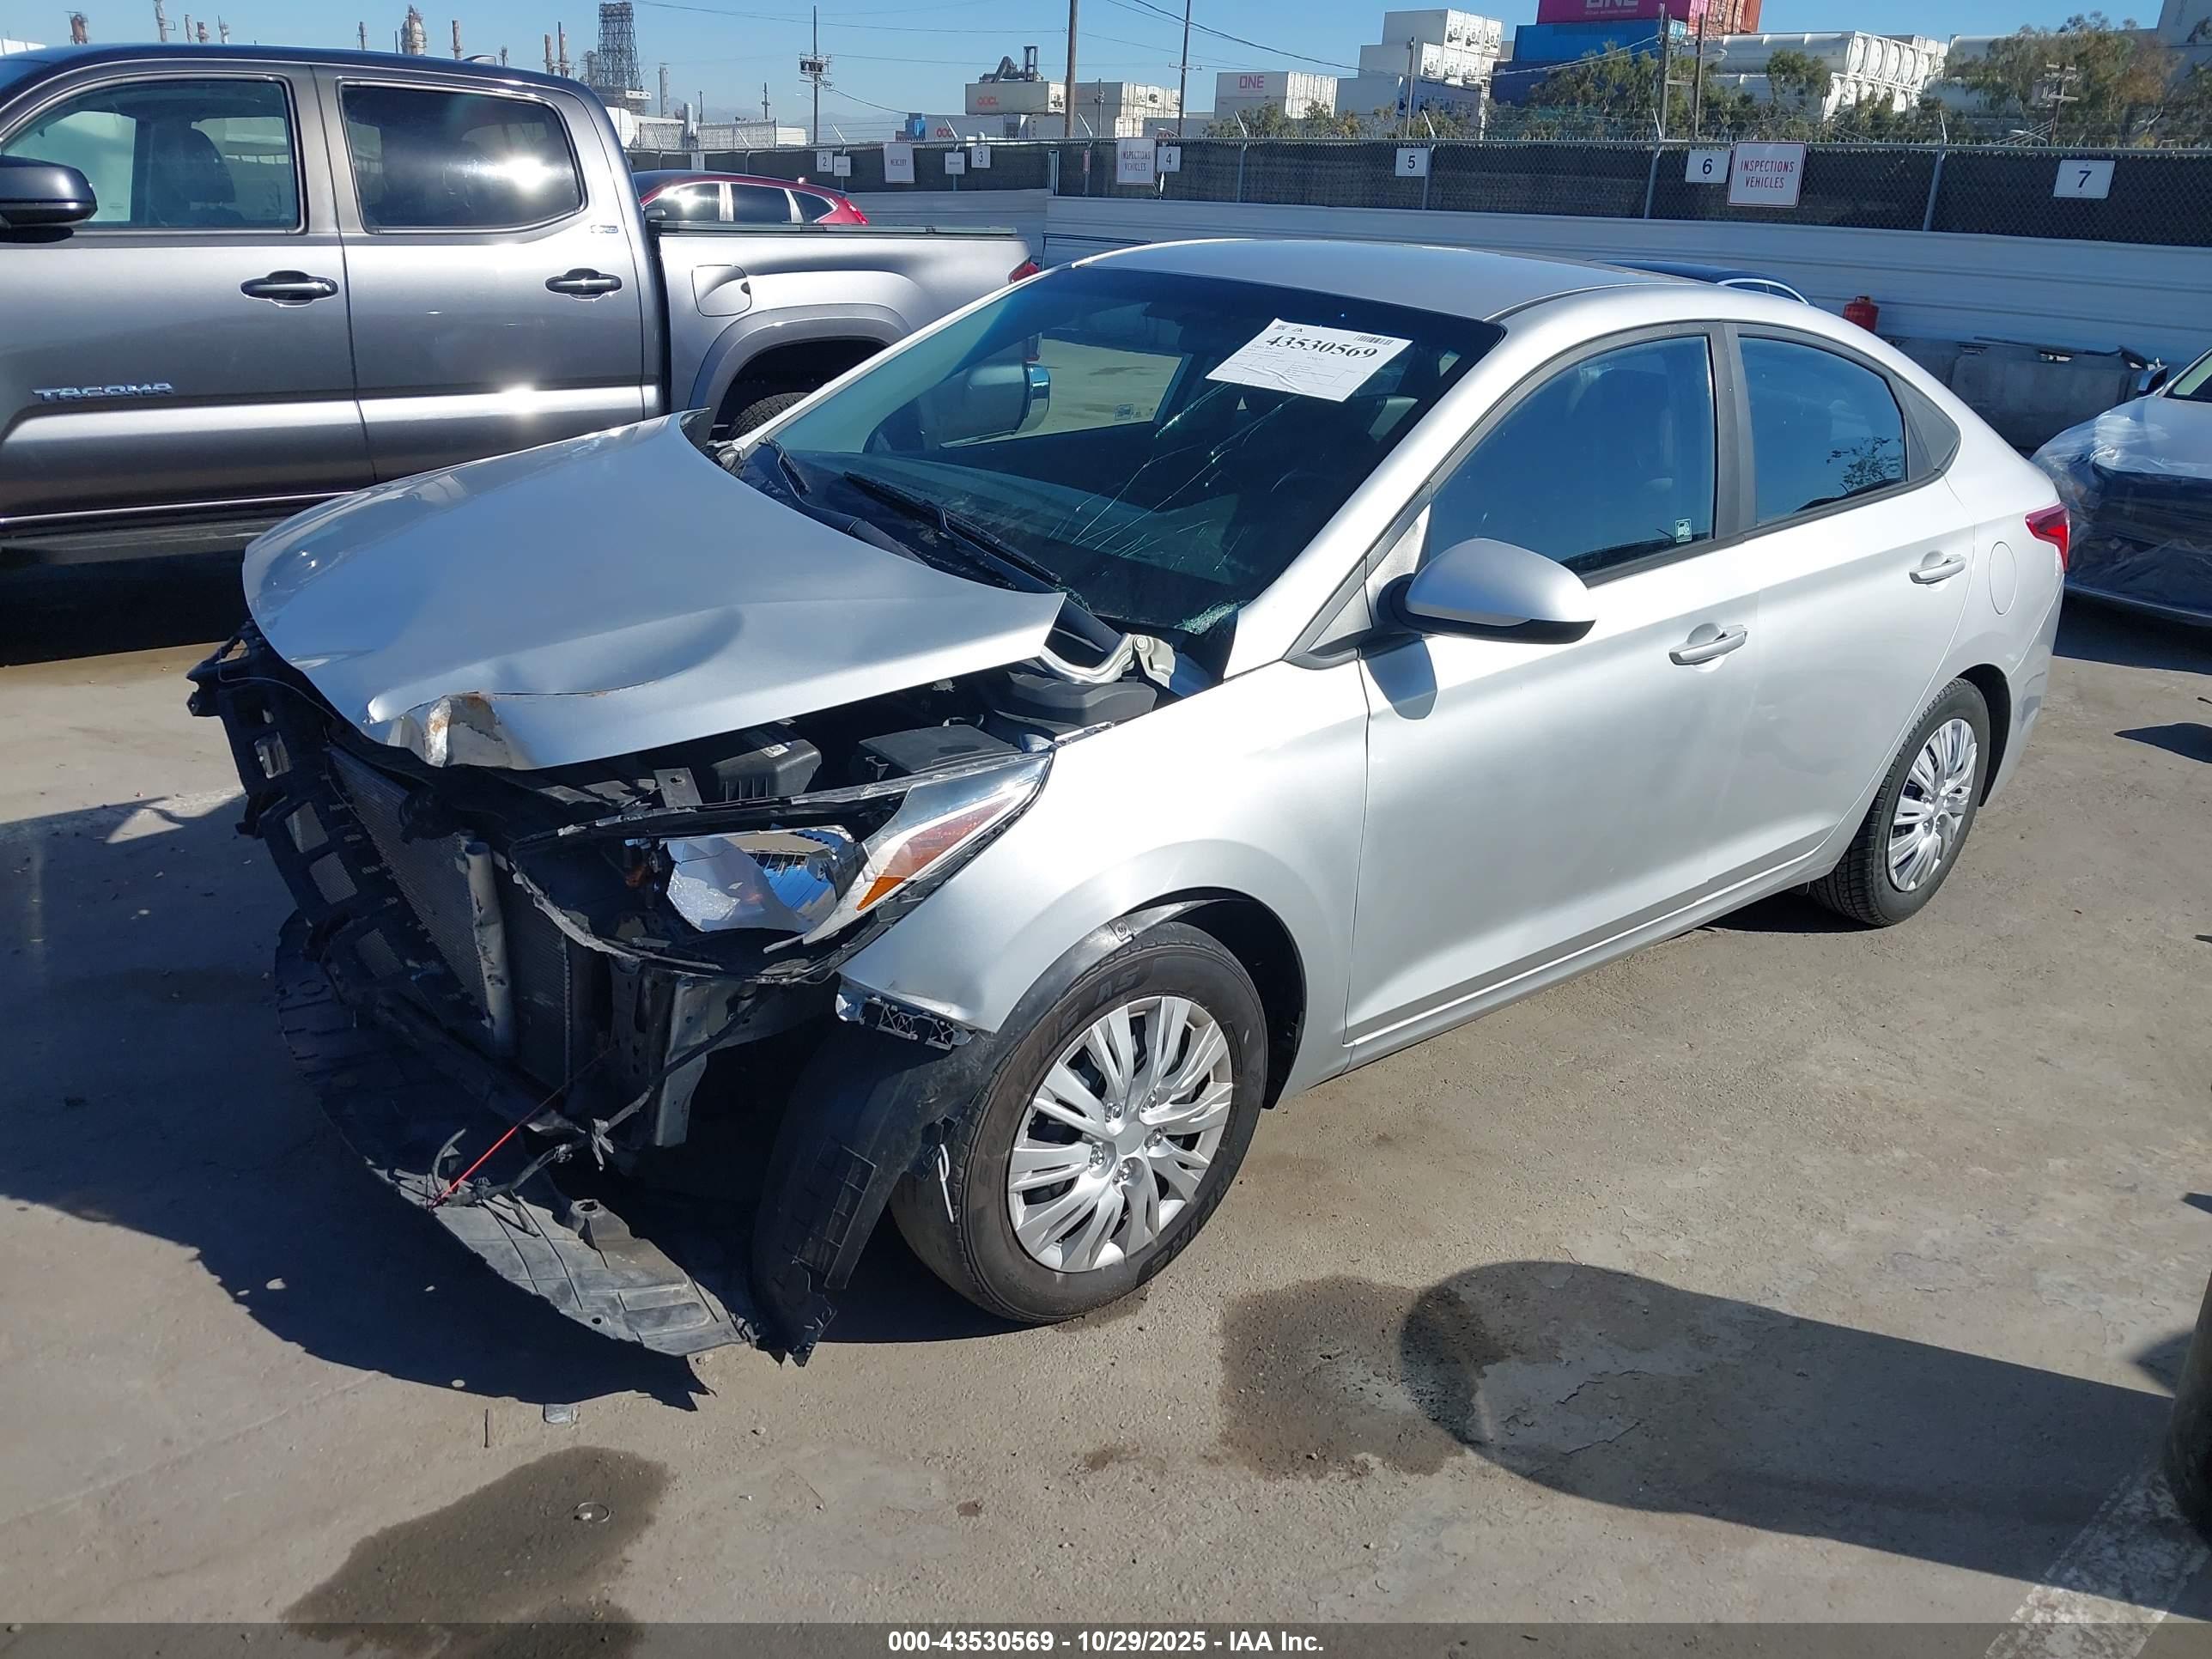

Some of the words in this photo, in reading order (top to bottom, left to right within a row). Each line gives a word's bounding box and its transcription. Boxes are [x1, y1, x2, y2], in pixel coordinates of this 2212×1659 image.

[1239, 76, 1264, 88] ONE
[822, 156, 827, 167] 2
[978, 150, 983, 163] 3
[1121, 150, 1151, 160] INSPECTIONS
[1165, 153, 1172, 166] 4
[1124, 162, 1146, 172] VEHICLES
[1407, 155, 1416, 169] 5
[1702, 158, 1713, 175] 6
[1740, 160, 1795, 173] INSPECTIONS
[1745, 176, 1784, 189] VEHICLES
[2078, 170, 2093, 188] 7
[1266, 335, 1377, 358] 43530569
[32, 383, 173, 401] TACOMA
